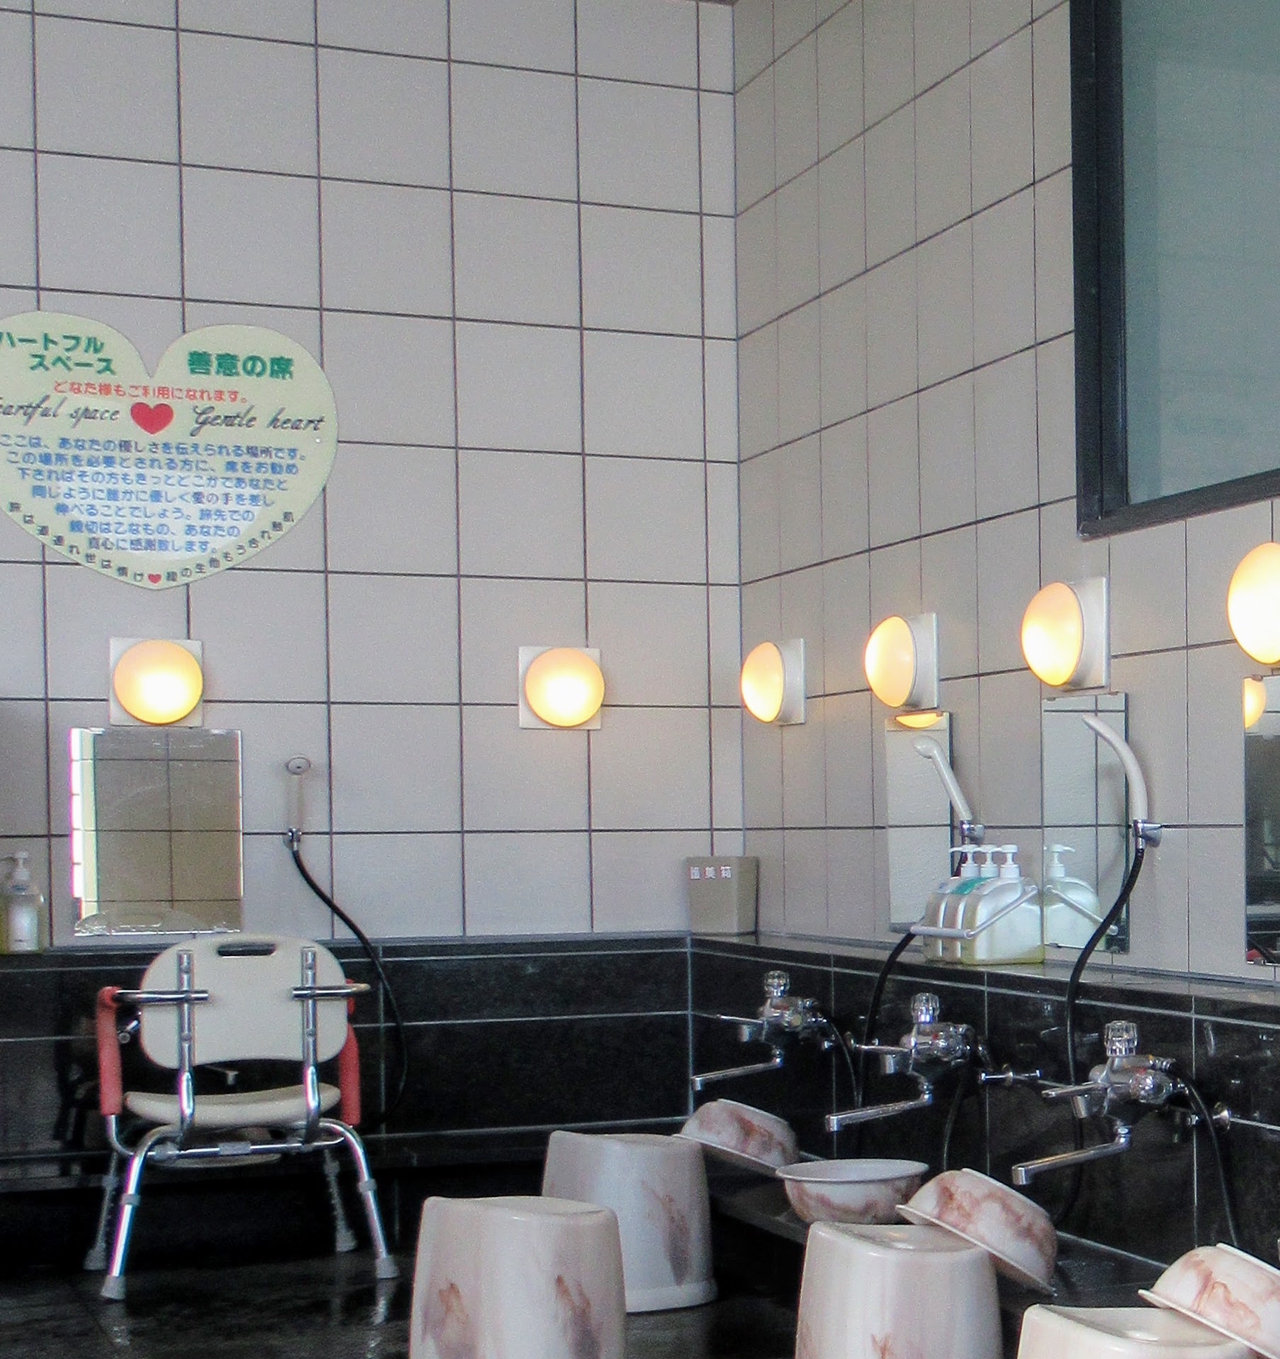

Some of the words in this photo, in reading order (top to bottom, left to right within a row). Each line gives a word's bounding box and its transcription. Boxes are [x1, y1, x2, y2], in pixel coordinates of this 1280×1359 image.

[0, 331, 105, 354] ハートフル
[29, 353, 117, 376] スペース
[187, 350, 294, 380] 善意の席
[54, 380, 248, 404] どなた様もご利用になれます。
[0, 394, 67, 426] artful
[68, 405, 120, 428] space
[189, 404, 257, 437] Gentle
[265, 406, 326, 431] heart
